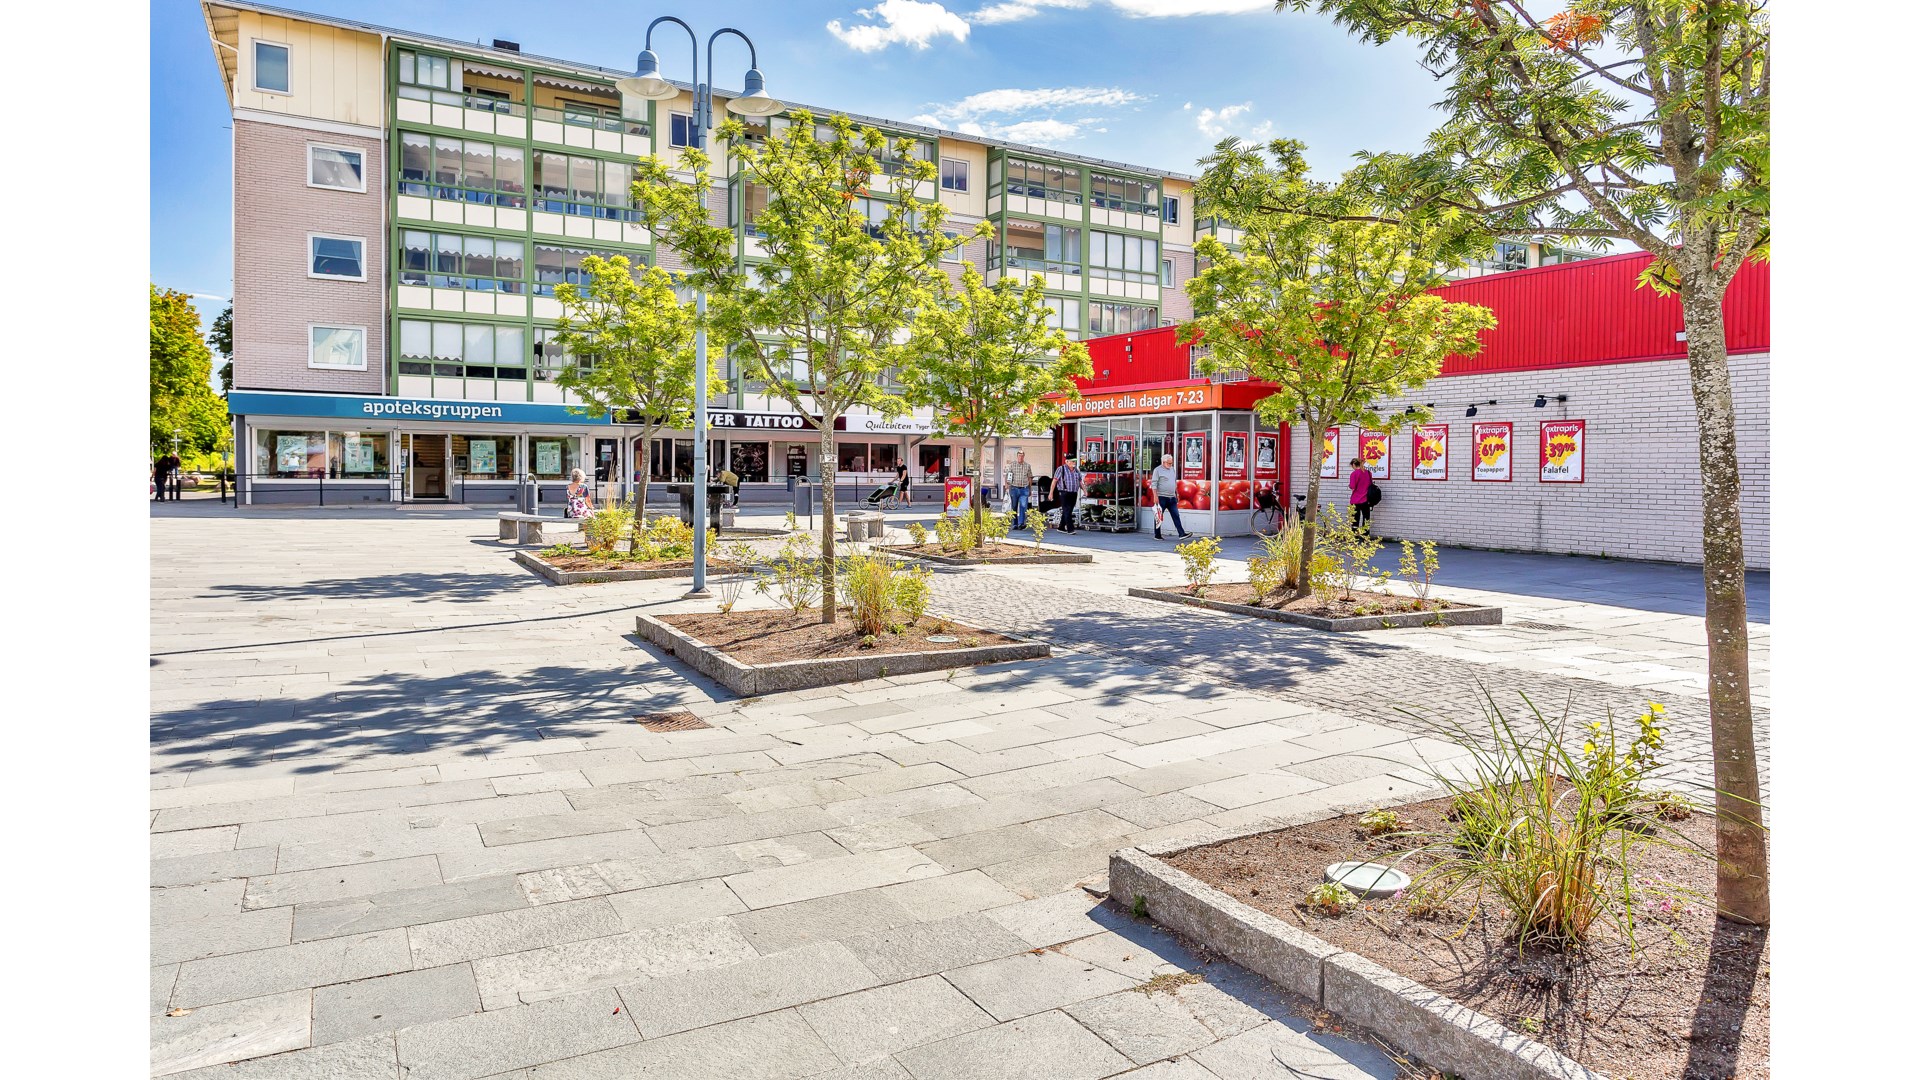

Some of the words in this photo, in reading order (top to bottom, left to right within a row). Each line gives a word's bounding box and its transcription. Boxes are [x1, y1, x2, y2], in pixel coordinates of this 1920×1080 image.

[1085, 398, 1115, 413] öppet
[1117, 395, 1136, 408] alla
[1139, 394, 1173, 410] dagar
[1176, 390, 1204, 405] 7-23
[363, 401, 502, 419] apoteksgruppen
[744, 415, 804, 428] TATTOO
[1545, 424, 1579, 433] extrapris
[1363, 465, 1385, 473] ringles
[1543, 466, 1569, 474] Falafel
